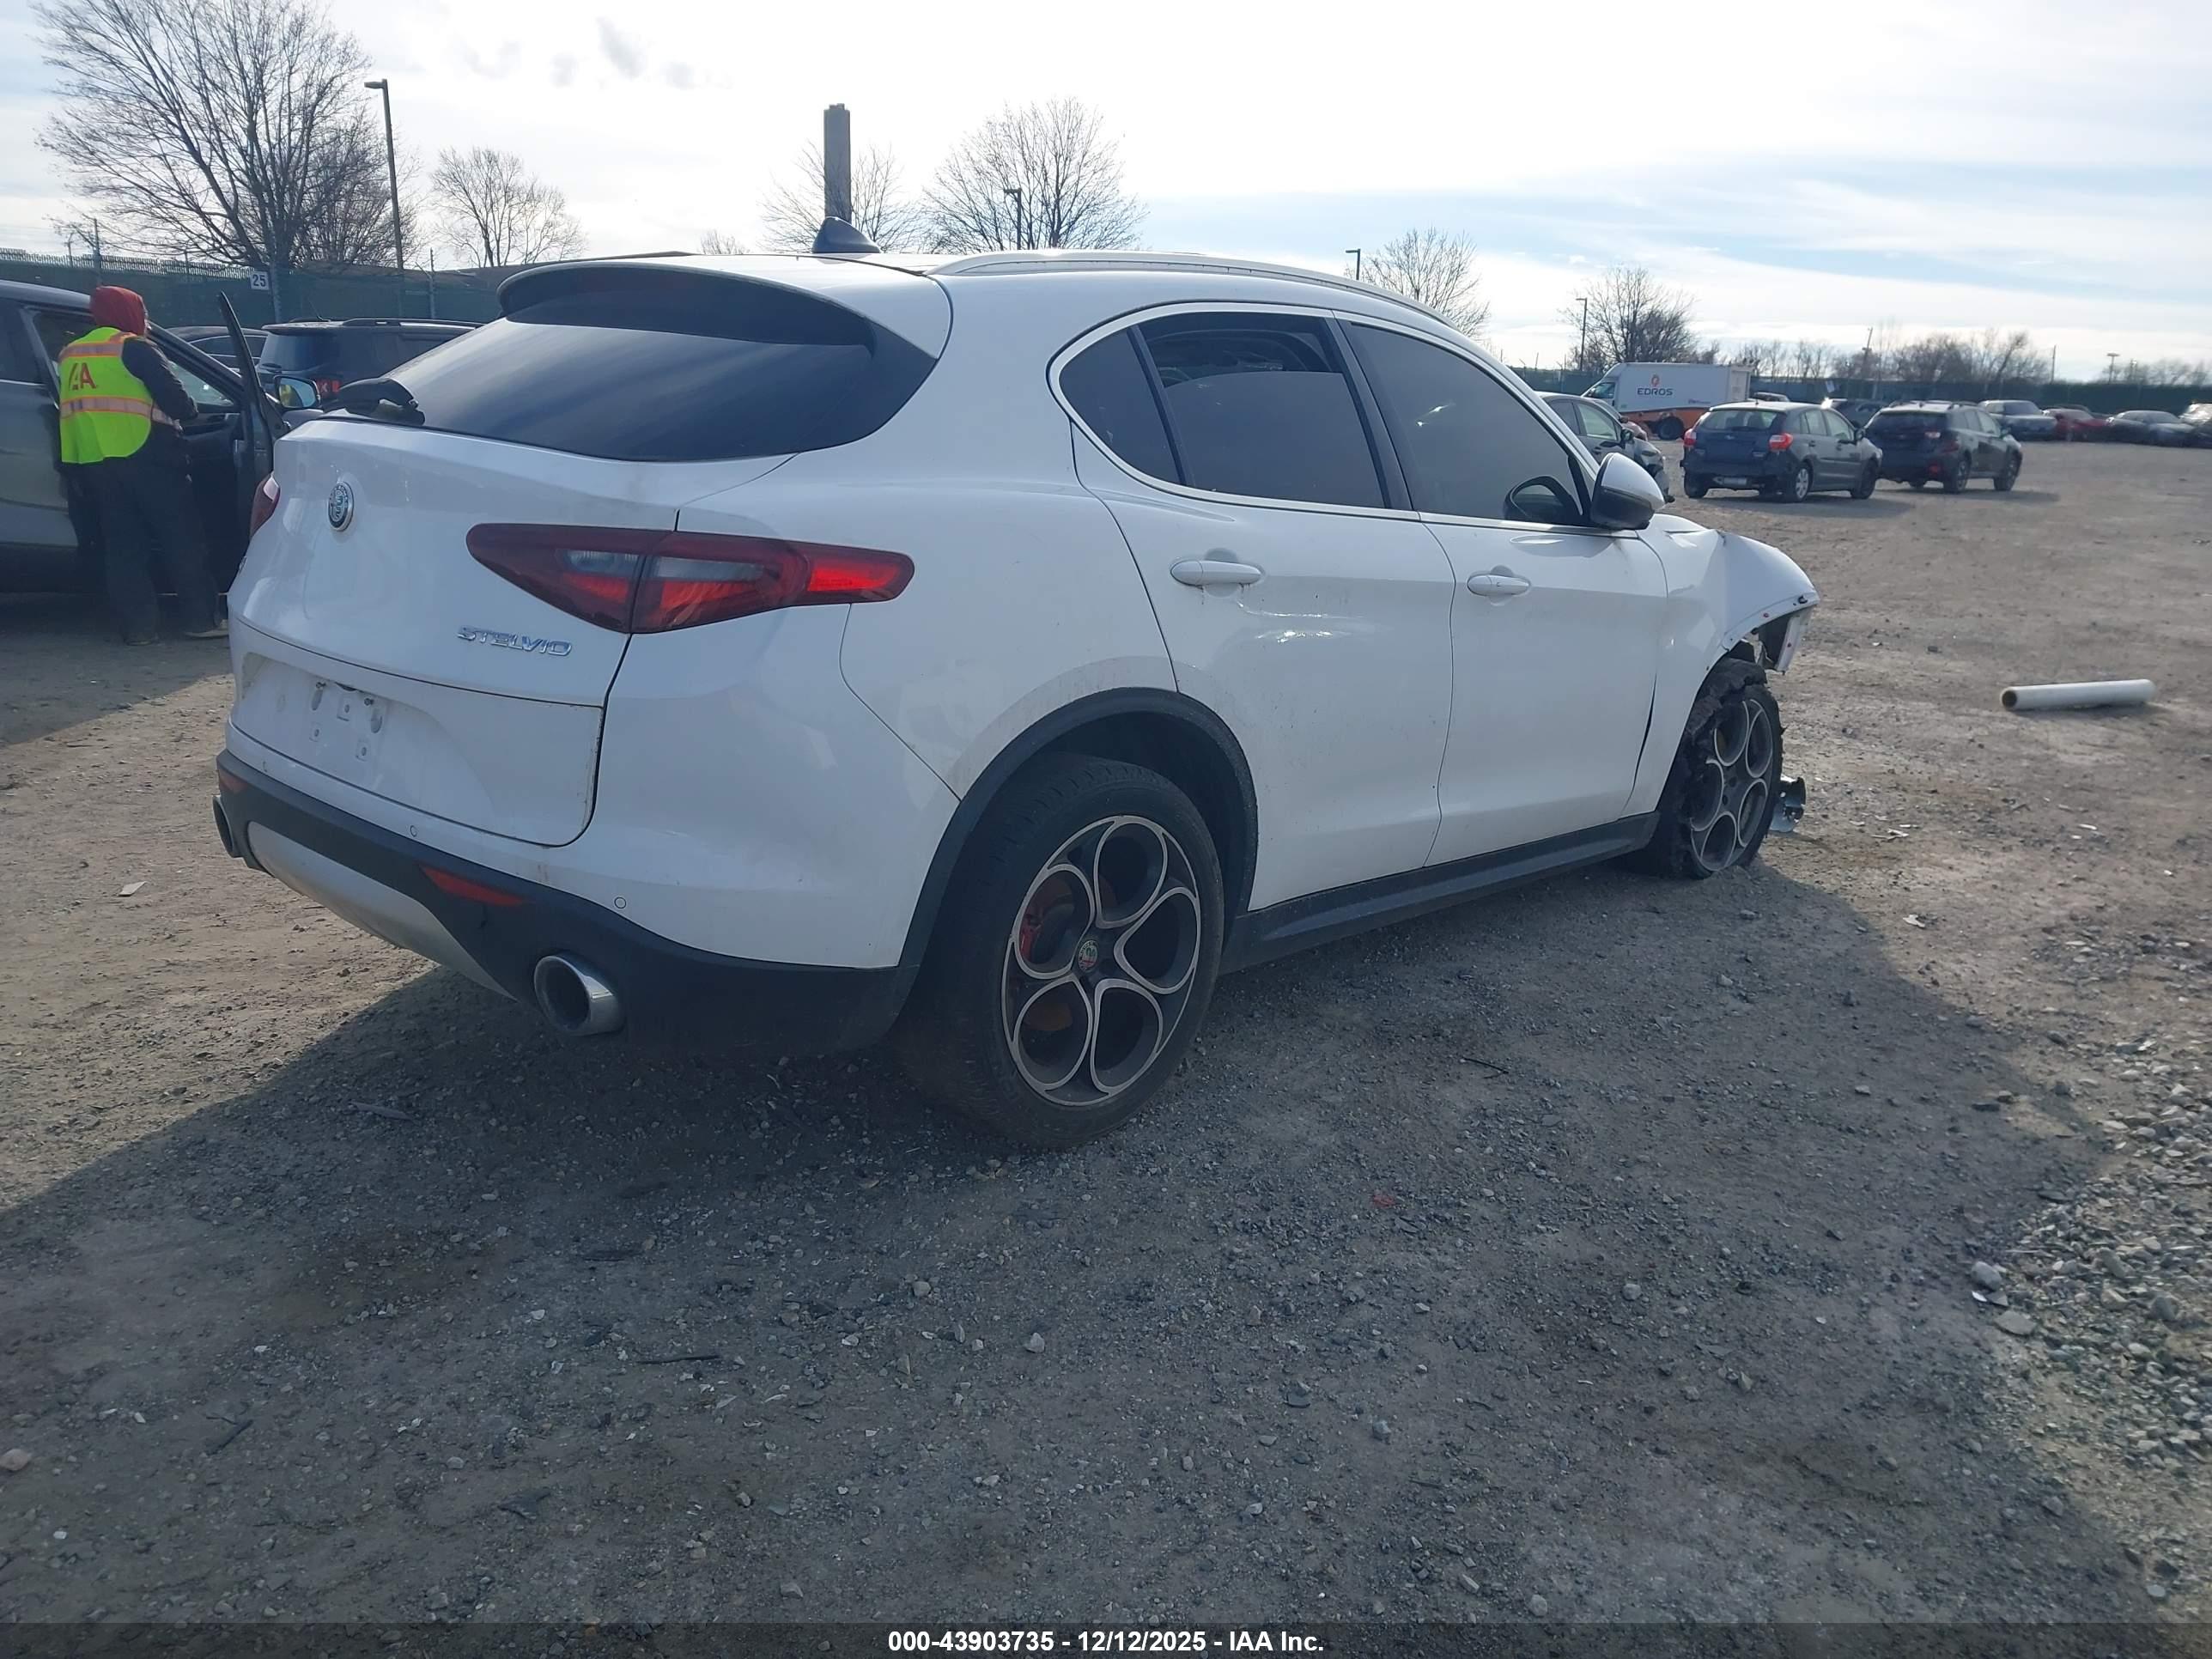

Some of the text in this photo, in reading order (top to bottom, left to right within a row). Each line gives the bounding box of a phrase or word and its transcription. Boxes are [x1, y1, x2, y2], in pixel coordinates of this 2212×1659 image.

[252, 274, 266, 287] 25
[1637, 387, 1674, 396] EDROS
[456, 625, 573, 656] STELVIO
